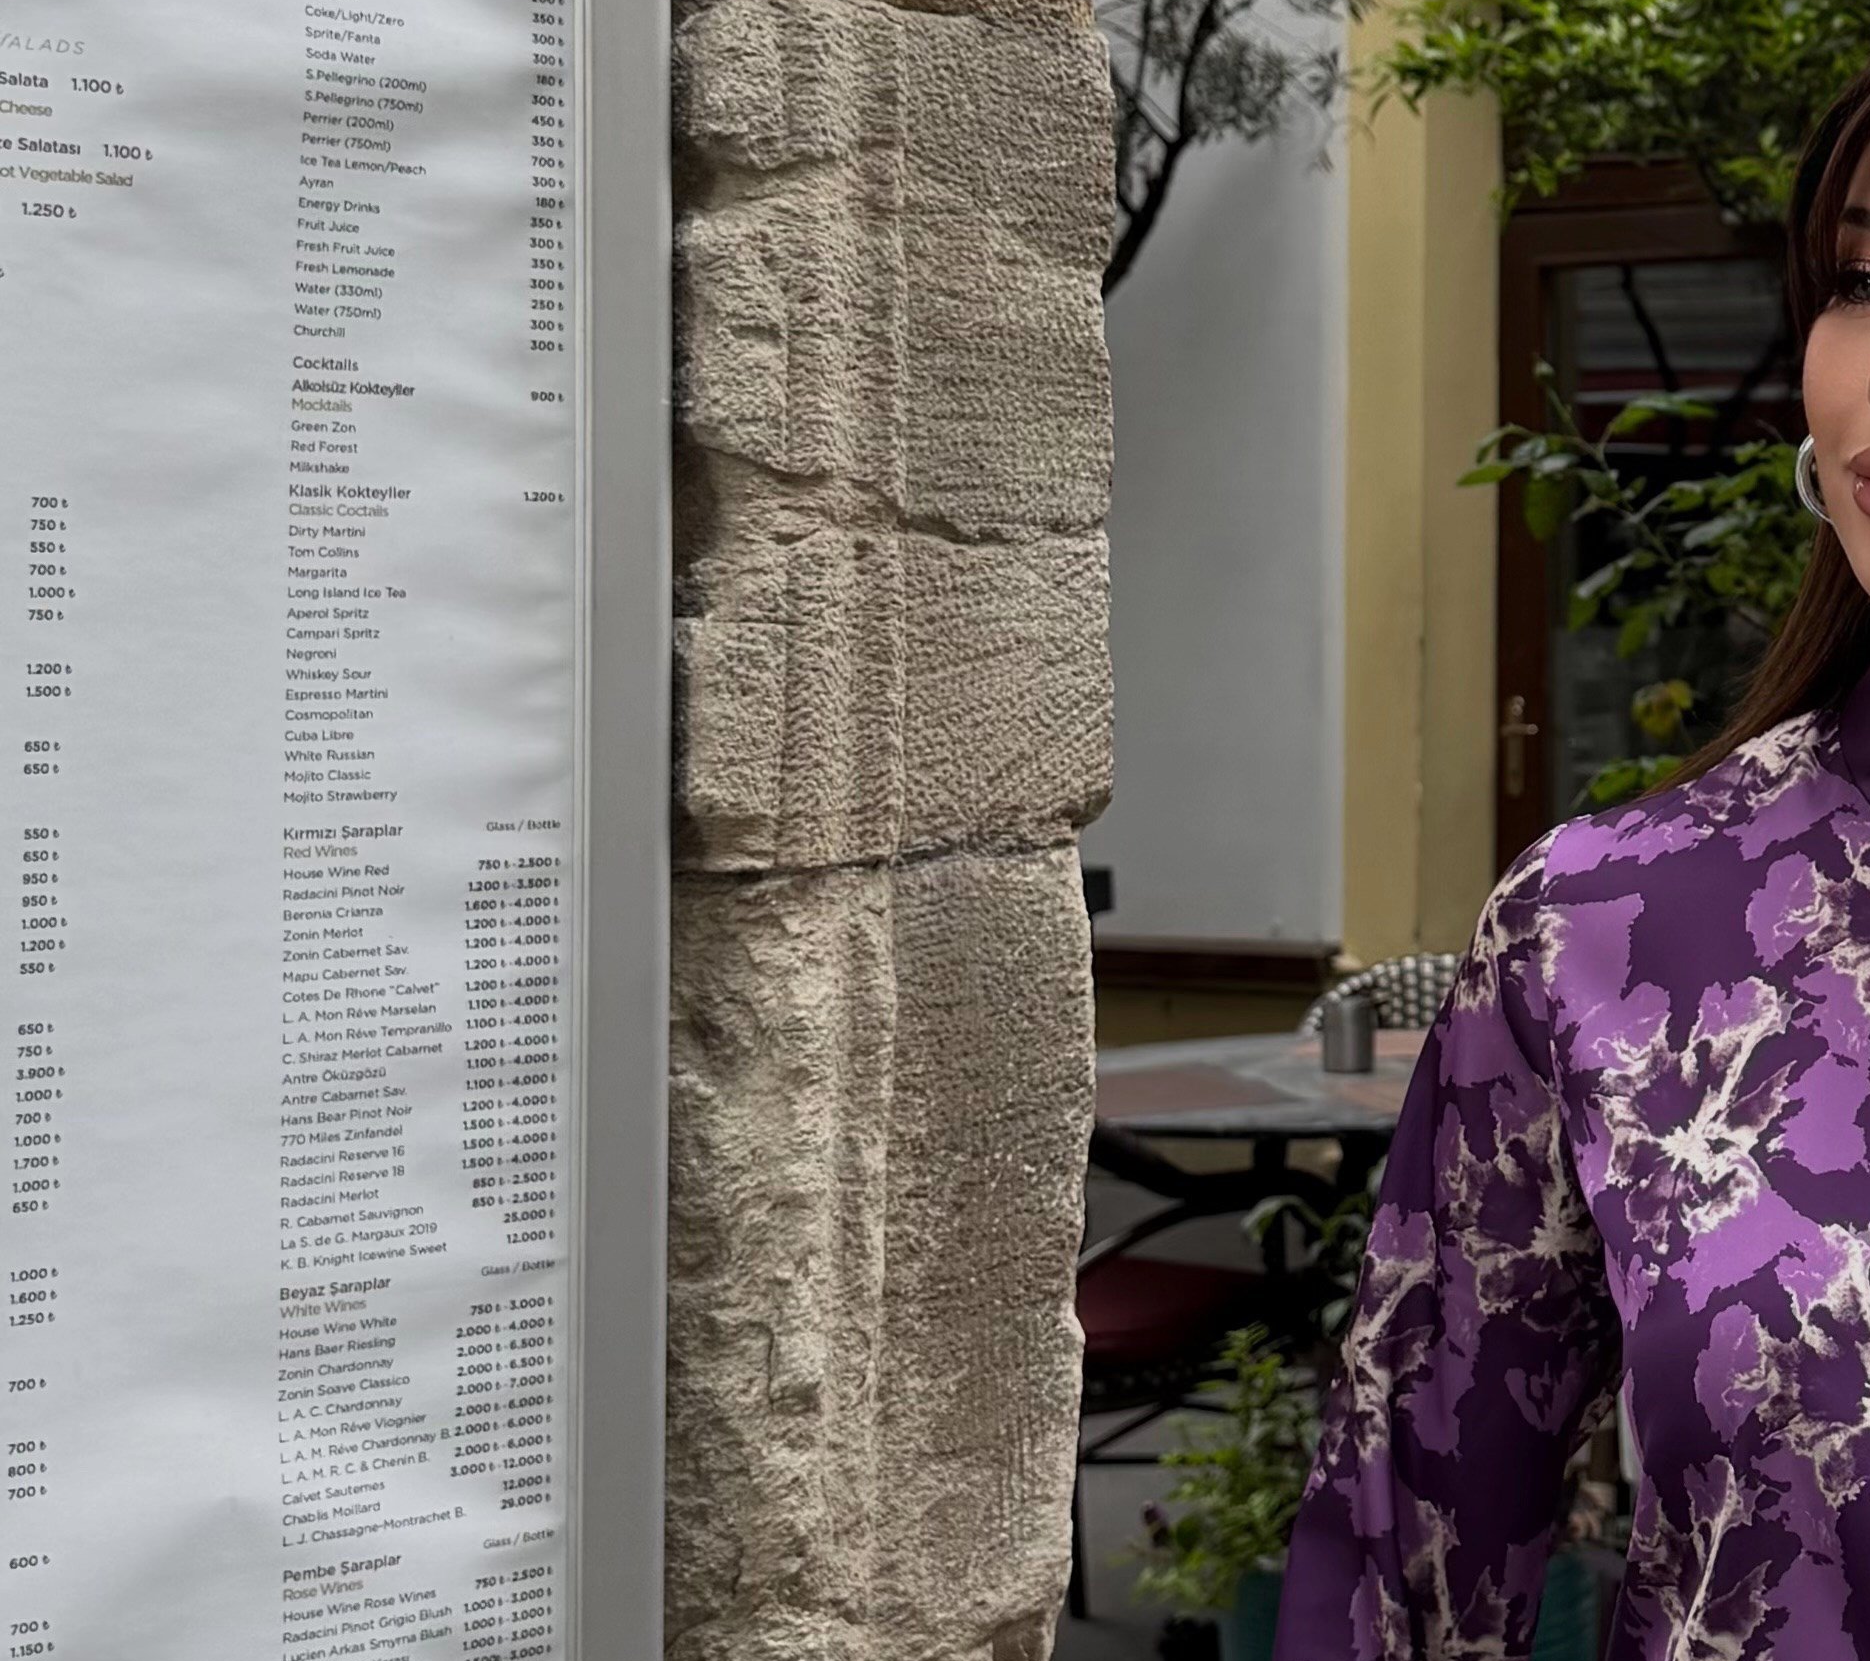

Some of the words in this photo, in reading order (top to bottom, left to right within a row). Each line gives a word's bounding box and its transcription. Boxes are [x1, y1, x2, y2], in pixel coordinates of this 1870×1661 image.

[305, 26, 381, 45] Sprite/Fanta
[306, 47, 337, 61] Soda
[340, 52, 376, 65] Water
[71, 78, 112, 94] 1.100
[18, 137, 81, 155] Salatası
[103, 144, 141, 160] 1.100
[531, 155, 555, 168] 700
[18, 166, 93, 184] Vegetable
[95, 171, 134, 187] Salad
[299, 176, 334, 189] Ayran
[22, 202, 64, 218] 1.250
[298, 196, 340, 213] Energy
[344, 200, 380, 214] Drinks
[296, 260, 329, 273] Fresh
[332, 263, 395, 278] Lemonade
[293, 324, 345, 338] Churchill
[292, 356, 359, 372] Cocktails
[292, 379, 347, 394] Alkolsüz
[350, 382, 415, 398] Kokteyller
[291, 398, 352, 413] Mocktails
[290, 420, 328, 432] Green
[332, 421, 356, 434] Zon
[290, 440, 316, 453] Red
[319, 440, 358, 454] Forest
[289, 461, 350, 474] Milkshake
[289, 484, 332, 498] Klasik
[336, 485, 411, 502] Kokteyller
[524, 491, 556, 502] 1.200
[31, 496, 58, 508] 700
[288, 503, 334, 516] Classic
[288, 524, 319, 539] Dirty
[322, 526, 366, 538] Martini
[288, 545, 315, 558] Tom
[318, 546, 360, 558] Collins
[288, 566, 348, 580] Margarita
[287, 587, 320, 600] Long
[323, 587, 360, 598] Island
[363, 587, 382, 598] Ice
[385, 586, 406, 598] Tea
[28, 609, 54, 621] 750
[286, 608, 329, 620] Aperol
[333, 607, 369, 620] Spritz
[286, 627, 340, 640] Campari
[343, 627, 380, 640] Spritz
[286, 648, 337, 661] Negroni
[26, 685, 62, 698] 1.500
[285, 688, 342, 702] Espresso
[346, 688, 388, 699] Martini
[285, 708, 374, 721] Cosmopolitan
[284, 730, 318, 742] Cuba
[322, 730, 354, 741] Libre
[284, 750, 322, 762] White
[326, 749, 375, 761] Russian
[284, 770, 324, 784] Mojito
[327, 769, 371, 781] Classic
[283, 828, 336, 840] Kırmızı
[342, 824, 404, 840] Şaraplar
[283, 846, 312, 859] Red
[314, 844, 358, 858] Wines
[283, 869, 324, 880] House
[328, 866, 361, 878] Wine
[364, 864, 390, 876] Red
[283, 930, 320, 942] Zonin
[323, 927, 363, 939] Merlot
[14, 1156, 49, 1170] 1.700
[280, 1286, 325, 1301] Beyaz
[330, 1277, 391, 1296] Şaraplar
[280, 1304, 321, 1319] White
[324, 1300, 367, 1313] Wines
[9, 1555, 38, 1570] 600
[283, 1566, 336, 1583] Pembe
[340, 1555, 402, 1576] Şaraplar
[282, 1587, 318, 1602] Rose
[320, 1580, 364, 1596] Wines
